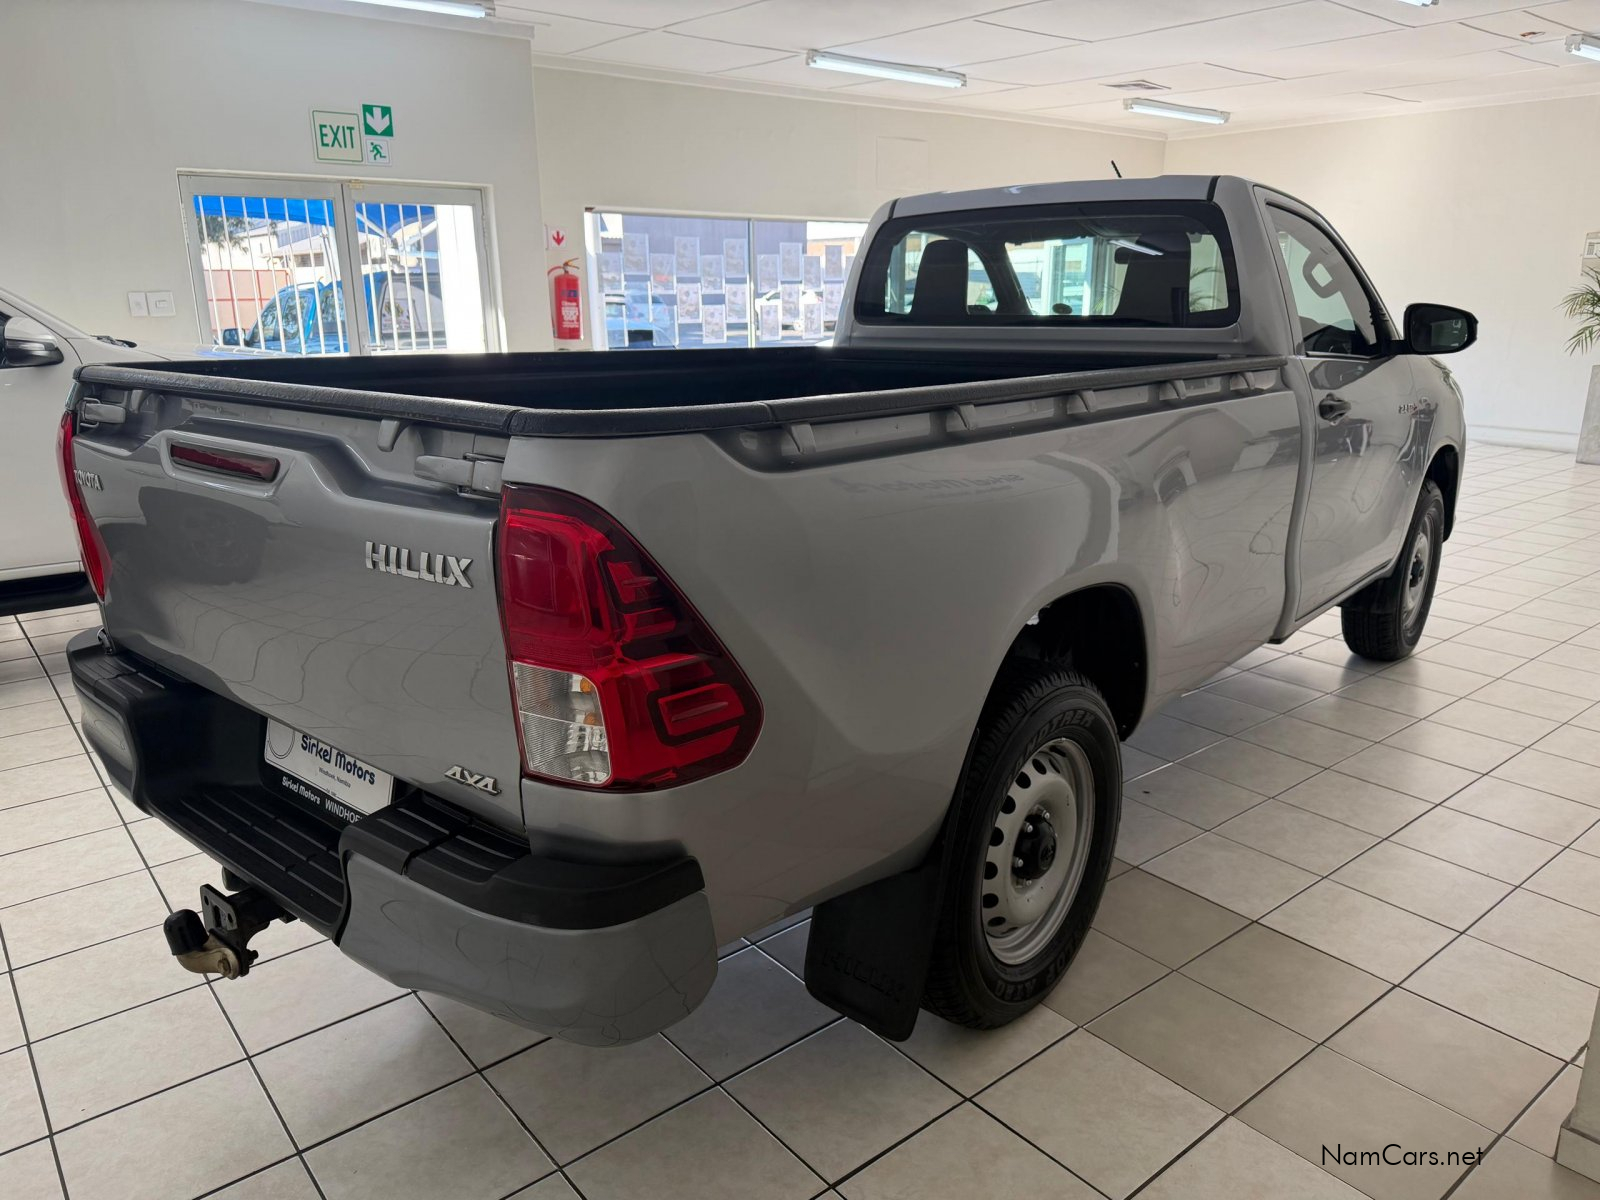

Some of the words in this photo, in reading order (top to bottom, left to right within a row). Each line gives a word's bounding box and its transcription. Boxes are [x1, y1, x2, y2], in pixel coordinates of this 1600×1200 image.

[319, 124, 355, 149] EXIT
[365, 541, 473, 588] HILUX
[301, 734, 332, 764] Sirkel
[335, 751, 375, 785] Motors
[281, 776, 299, 793] Sirkel
[299, 785, 321, 804] Motors
[325, 797, 363, 823] WINDHOE
